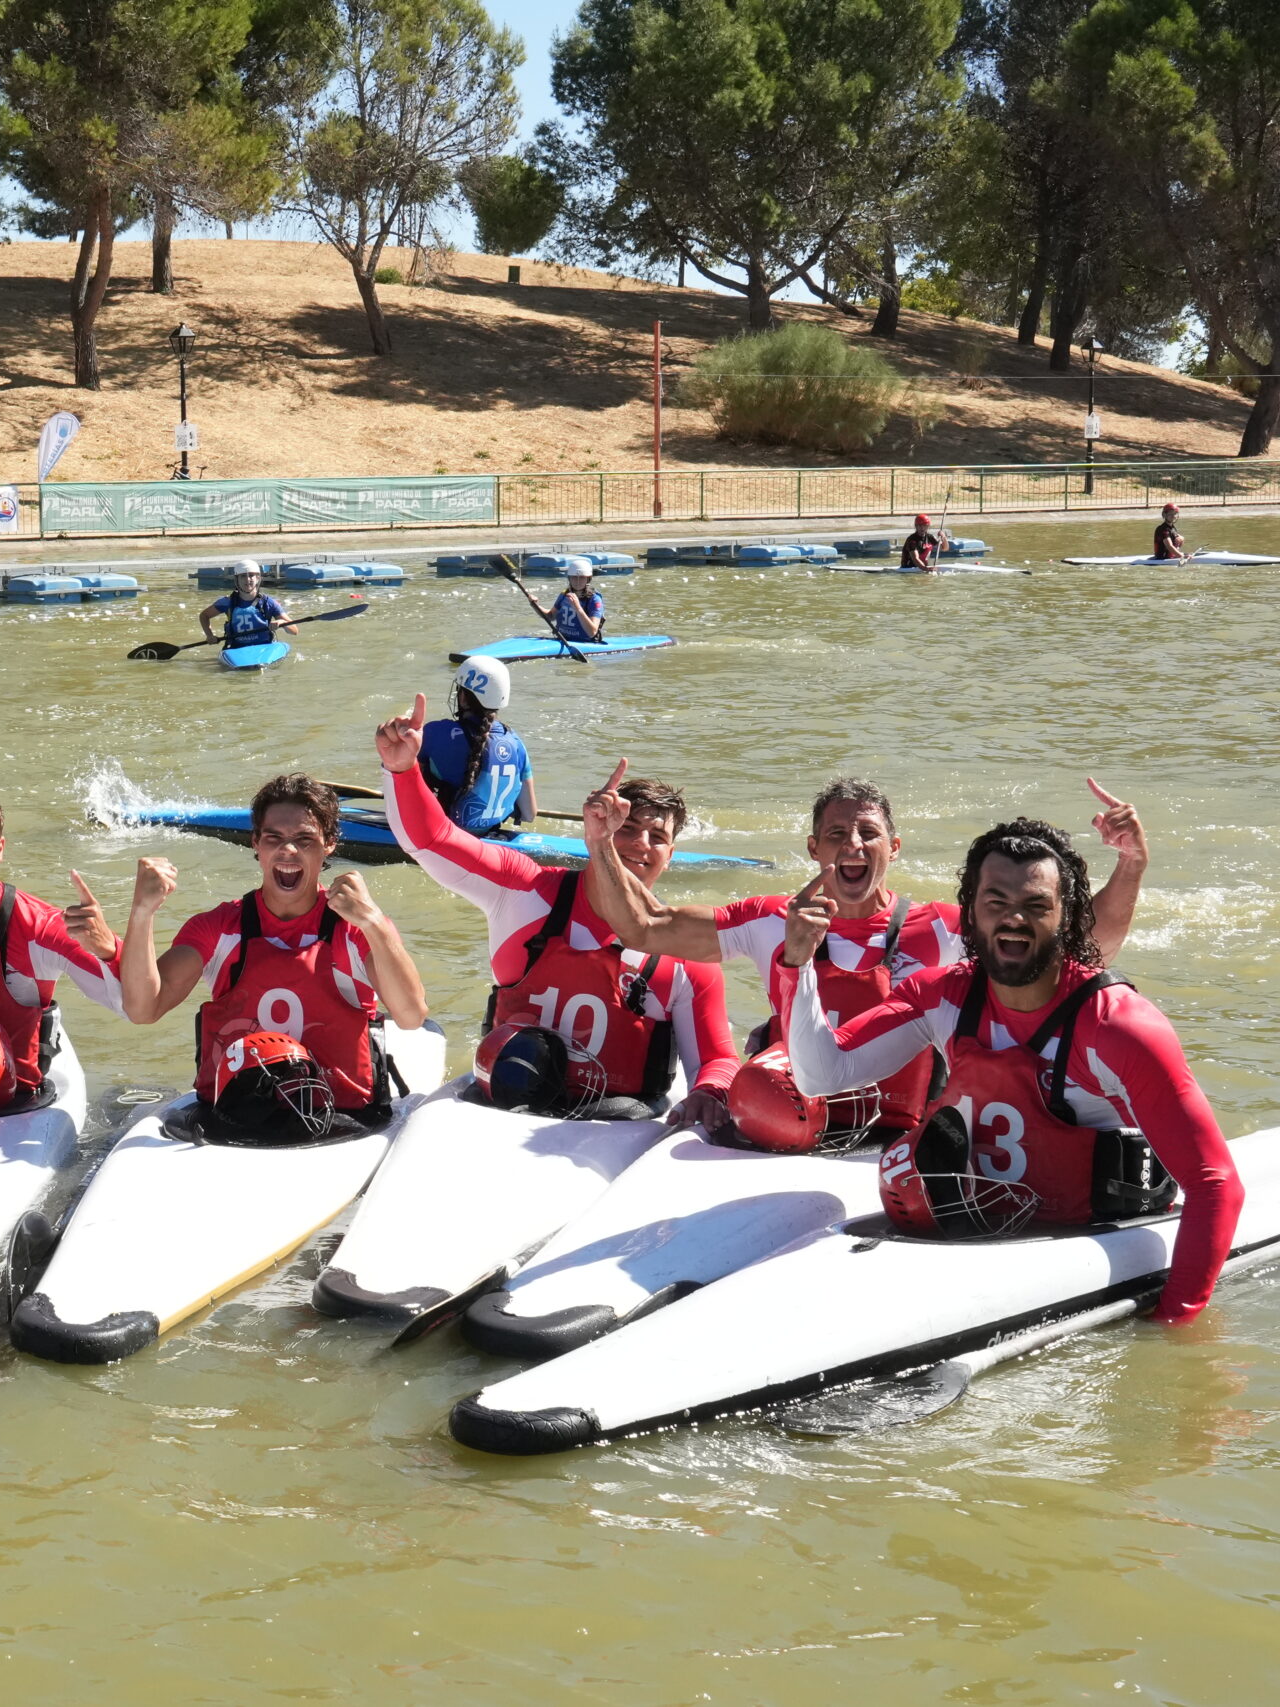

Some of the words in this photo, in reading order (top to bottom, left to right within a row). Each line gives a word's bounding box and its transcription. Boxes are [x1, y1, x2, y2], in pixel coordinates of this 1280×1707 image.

[60, 506, 113, 517] PARLA
[143, 504, 193, 515] PARLA
[222, 501, 270, 512] PARLA
[375, 499, 421, 509] PARLA
[448, 498, 493, 508] PARLA
[236, 614, 254, 633] 25
[561, 607, 576, 626] 32
[257, 988, 304, 1044] 9
[528, 986, 608, 1063] 10
[226, 1038, 245, 1072] 9
[882, 1143, 912, 1185] 13
